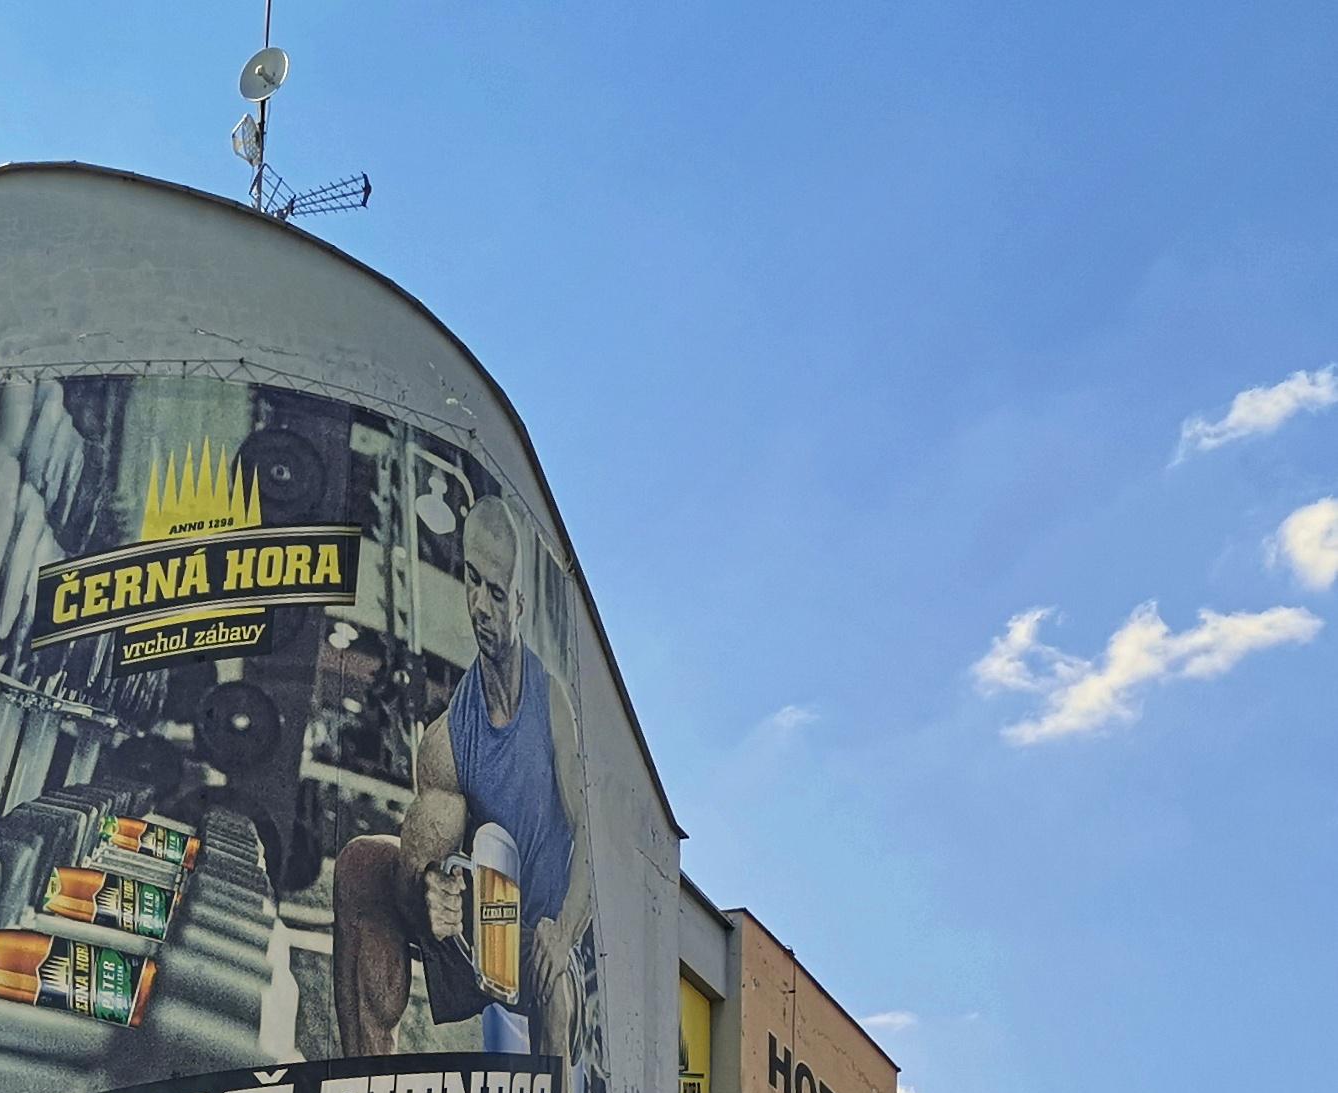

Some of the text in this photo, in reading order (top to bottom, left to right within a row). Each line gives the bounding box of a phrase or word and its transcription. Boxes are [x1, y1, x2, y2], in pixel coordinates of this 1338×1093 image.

[169, 521, 204, 535] ANNO
[52, 543, 342, 624] ČERNÁ HORA
[122, 622, 266, 660] vrchol zábavy
